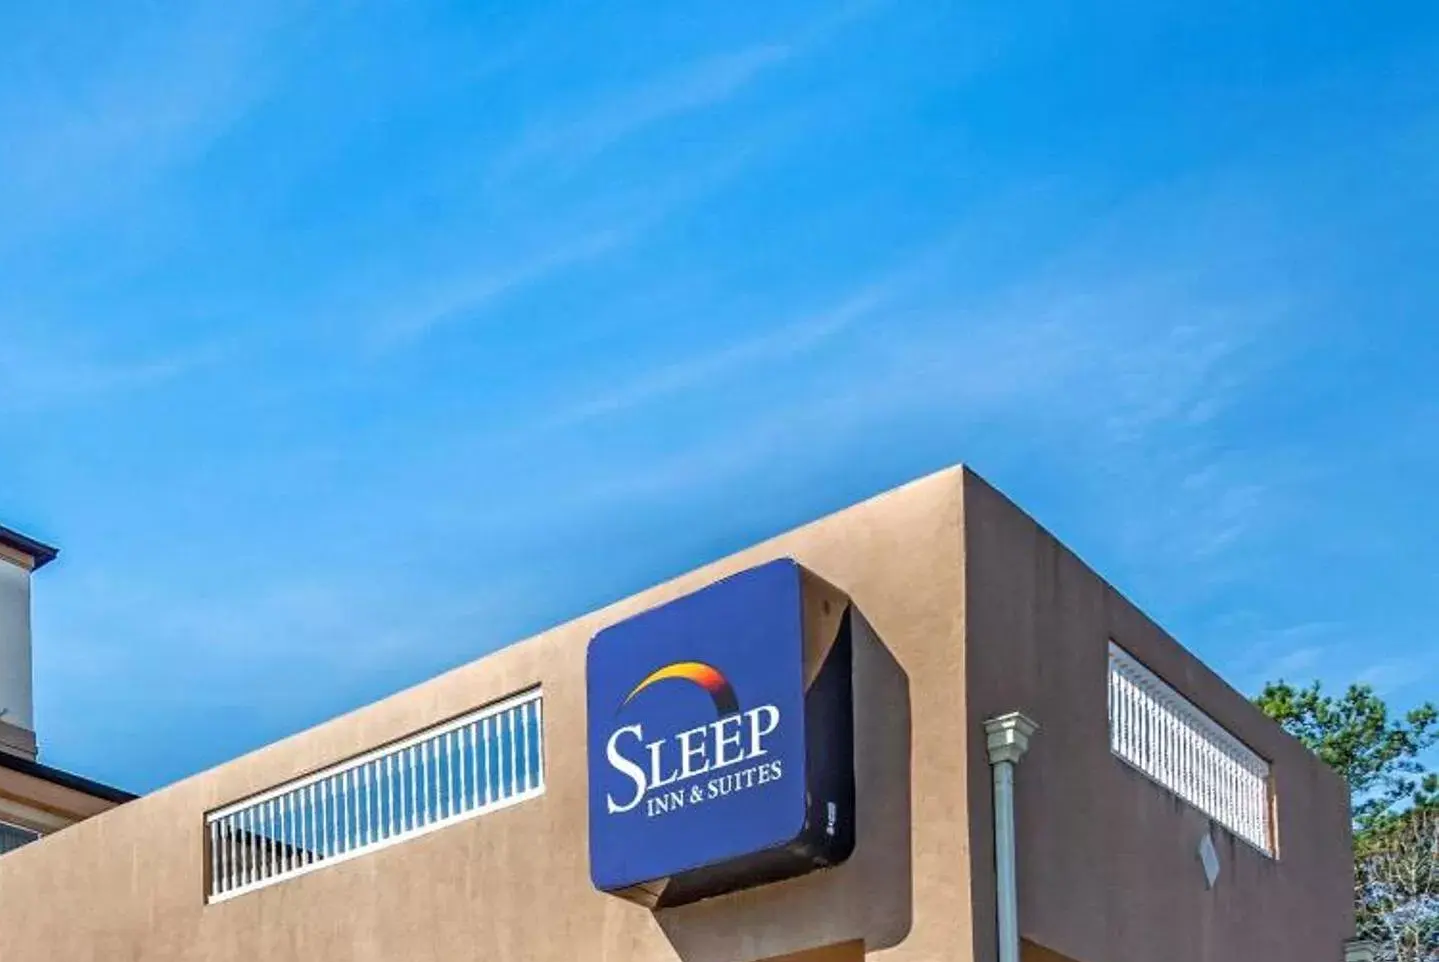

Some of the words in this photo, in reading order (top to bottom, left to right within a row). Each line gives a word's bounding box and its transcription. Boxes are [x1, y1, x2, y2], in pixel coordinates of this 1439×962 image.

[606, 704, 781, 815] SLEEP
[647, 790, 685, 816] INN
[689, 785, 704, 804] &
[707, 760, 783, 799] SUITES
